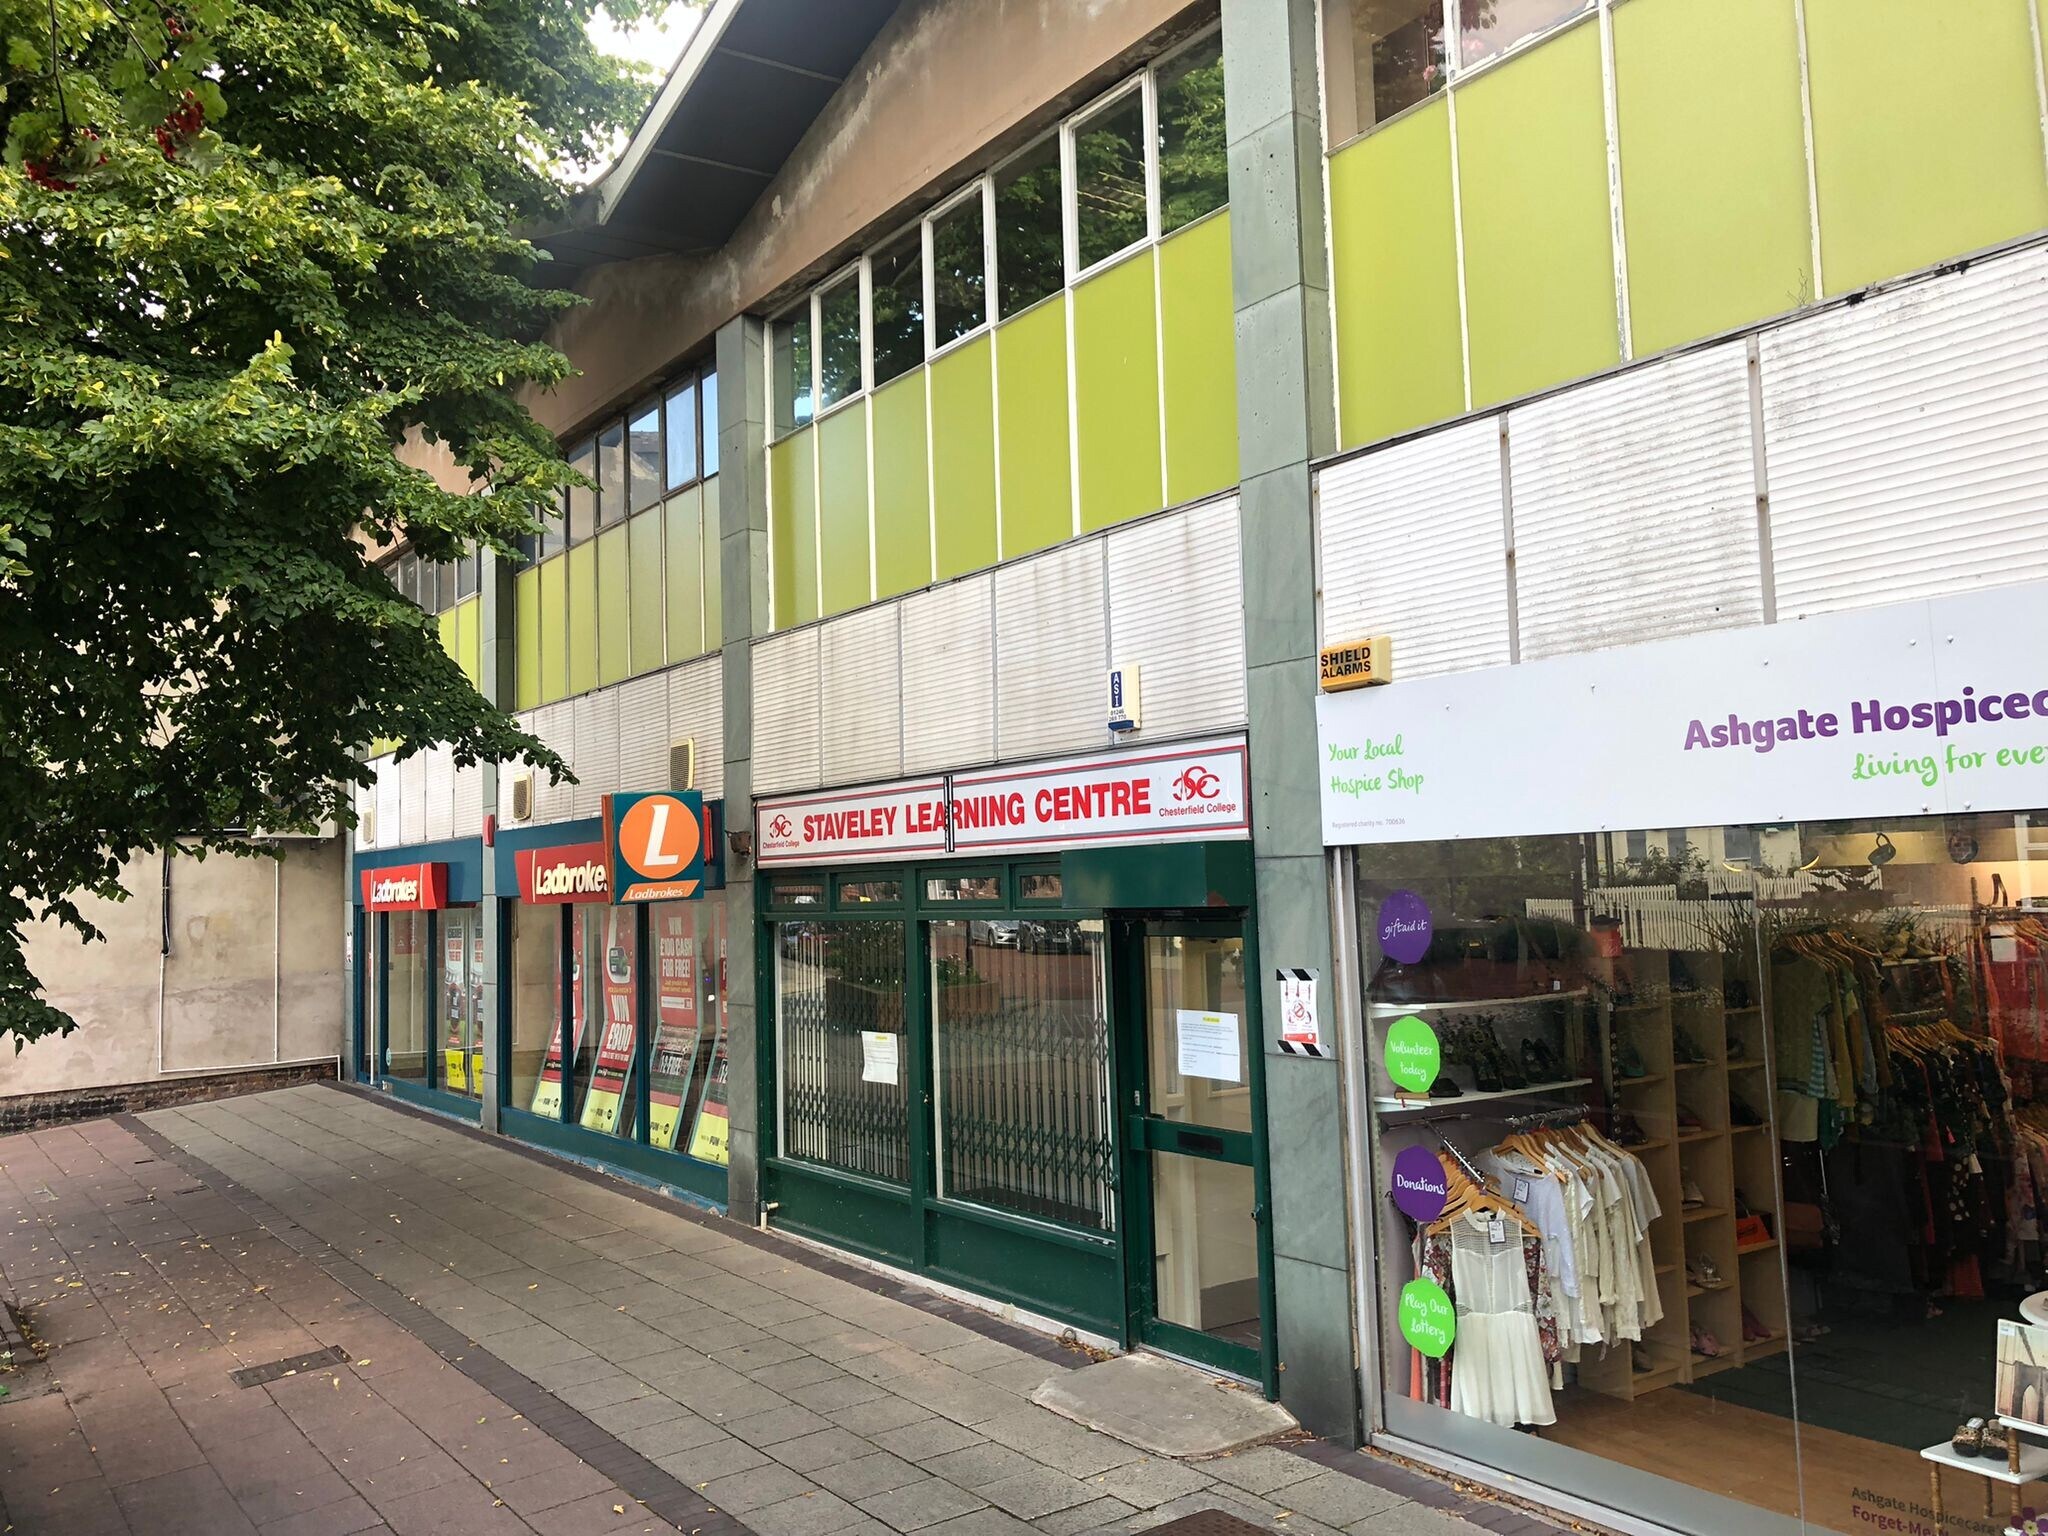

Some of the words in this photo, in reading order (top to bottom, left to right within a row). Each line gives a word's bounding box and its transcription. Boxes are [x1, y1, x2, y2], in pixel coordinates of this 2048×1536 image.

[1321, 647, 1370, 667] SHIELD
[1321, 660, 1371, 680] ALARMS
[1684, 709, 1839, 753] Ashgate
[1328, 743, 1360, 762] Your
[1364, 733, 1405, 761] Local
[1851, 751, 1939, 788] Living
[1945, 743, 1987, 774] for
[1996, 744, 2048, 767] eve
[1331, 773, 1383, 800] Hospice
[1387, 767, 1425, 796] Shop
[803, 806, 897, 842] STAVELEY
[906, 792, 1025, 834] LEARNING
[1035, 778, 1151, 823] CENTRE
[1159, 804, 1204, 817] Chesterfield
[1206, 802, 1237, 813] College
[643, 804, 679, 866] L
[372, 877, 418, 903] Ladbrokes
[629, 885, 684, 900] Ladbrokes
[1390, 1040, 1434, 1057] Volunteer
[1399, 1061, 1427, 1082] today
[1396, 1173, 1446, 1196] Donations
[1405, 1292, 1428, 1317] Play
[1429, 1299, 1449, 1316] Our
[1411, 1319, 1446, 1345] Lottery
[1852, 1486, 1907, 1513] Ashgate
